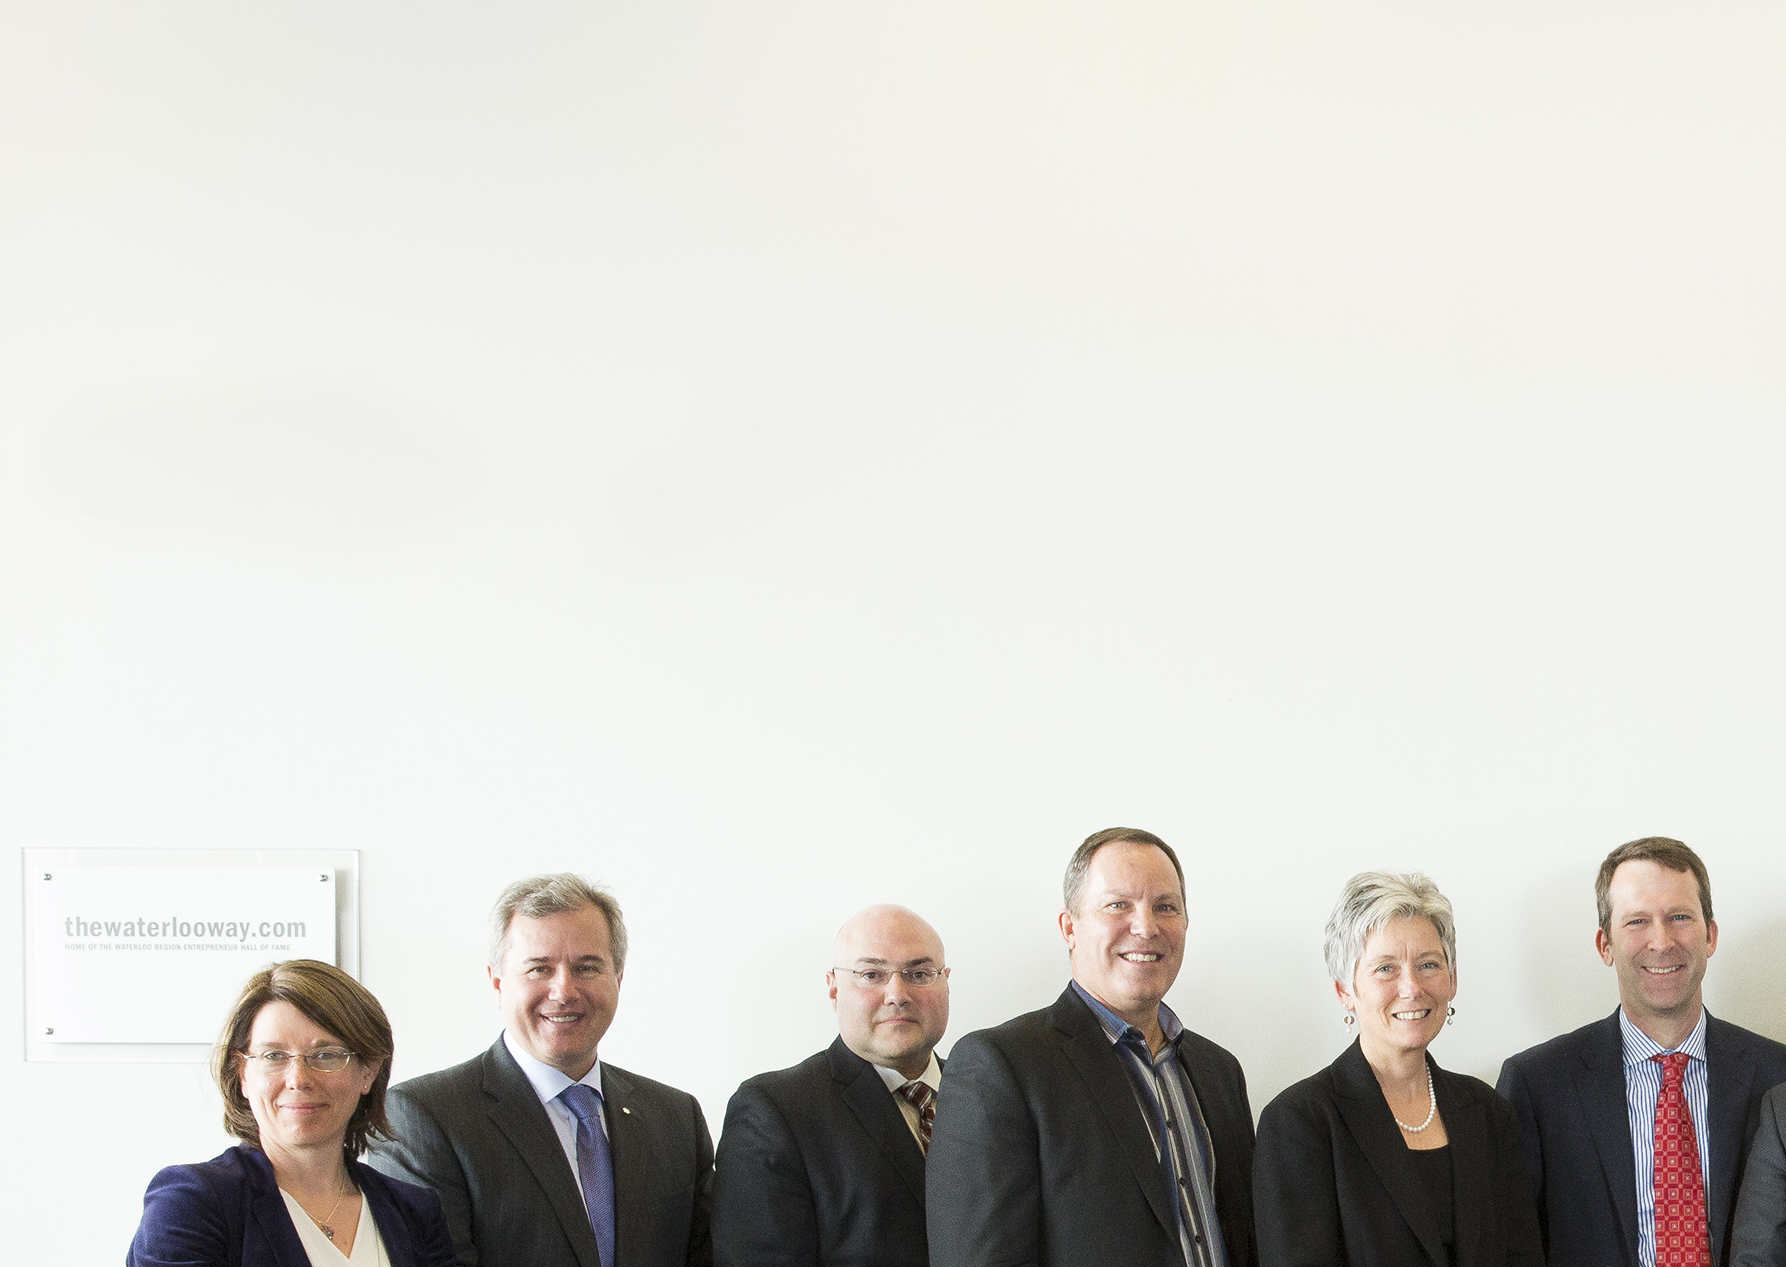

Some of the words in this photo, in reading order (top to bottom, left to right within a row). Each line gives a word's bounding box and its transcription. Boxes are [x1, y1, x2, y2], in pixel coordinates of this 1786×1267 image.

[65, 916, 306, 942] thewaterlooway.com
[65, 943, 86, 951] HOME
[88, 943, 98, 951] OF
[99, 943, 113, 951] THE
[115, 943, 153, 951] WATERLOO
[154, 943, 182, 951] REGION
[183, 943, 239, 951] ENTREPRENEUR
[240, 943, 258, 951] HALL
[260, 943, 270, 951] OF
[271, 943, 291, 951] FAME
